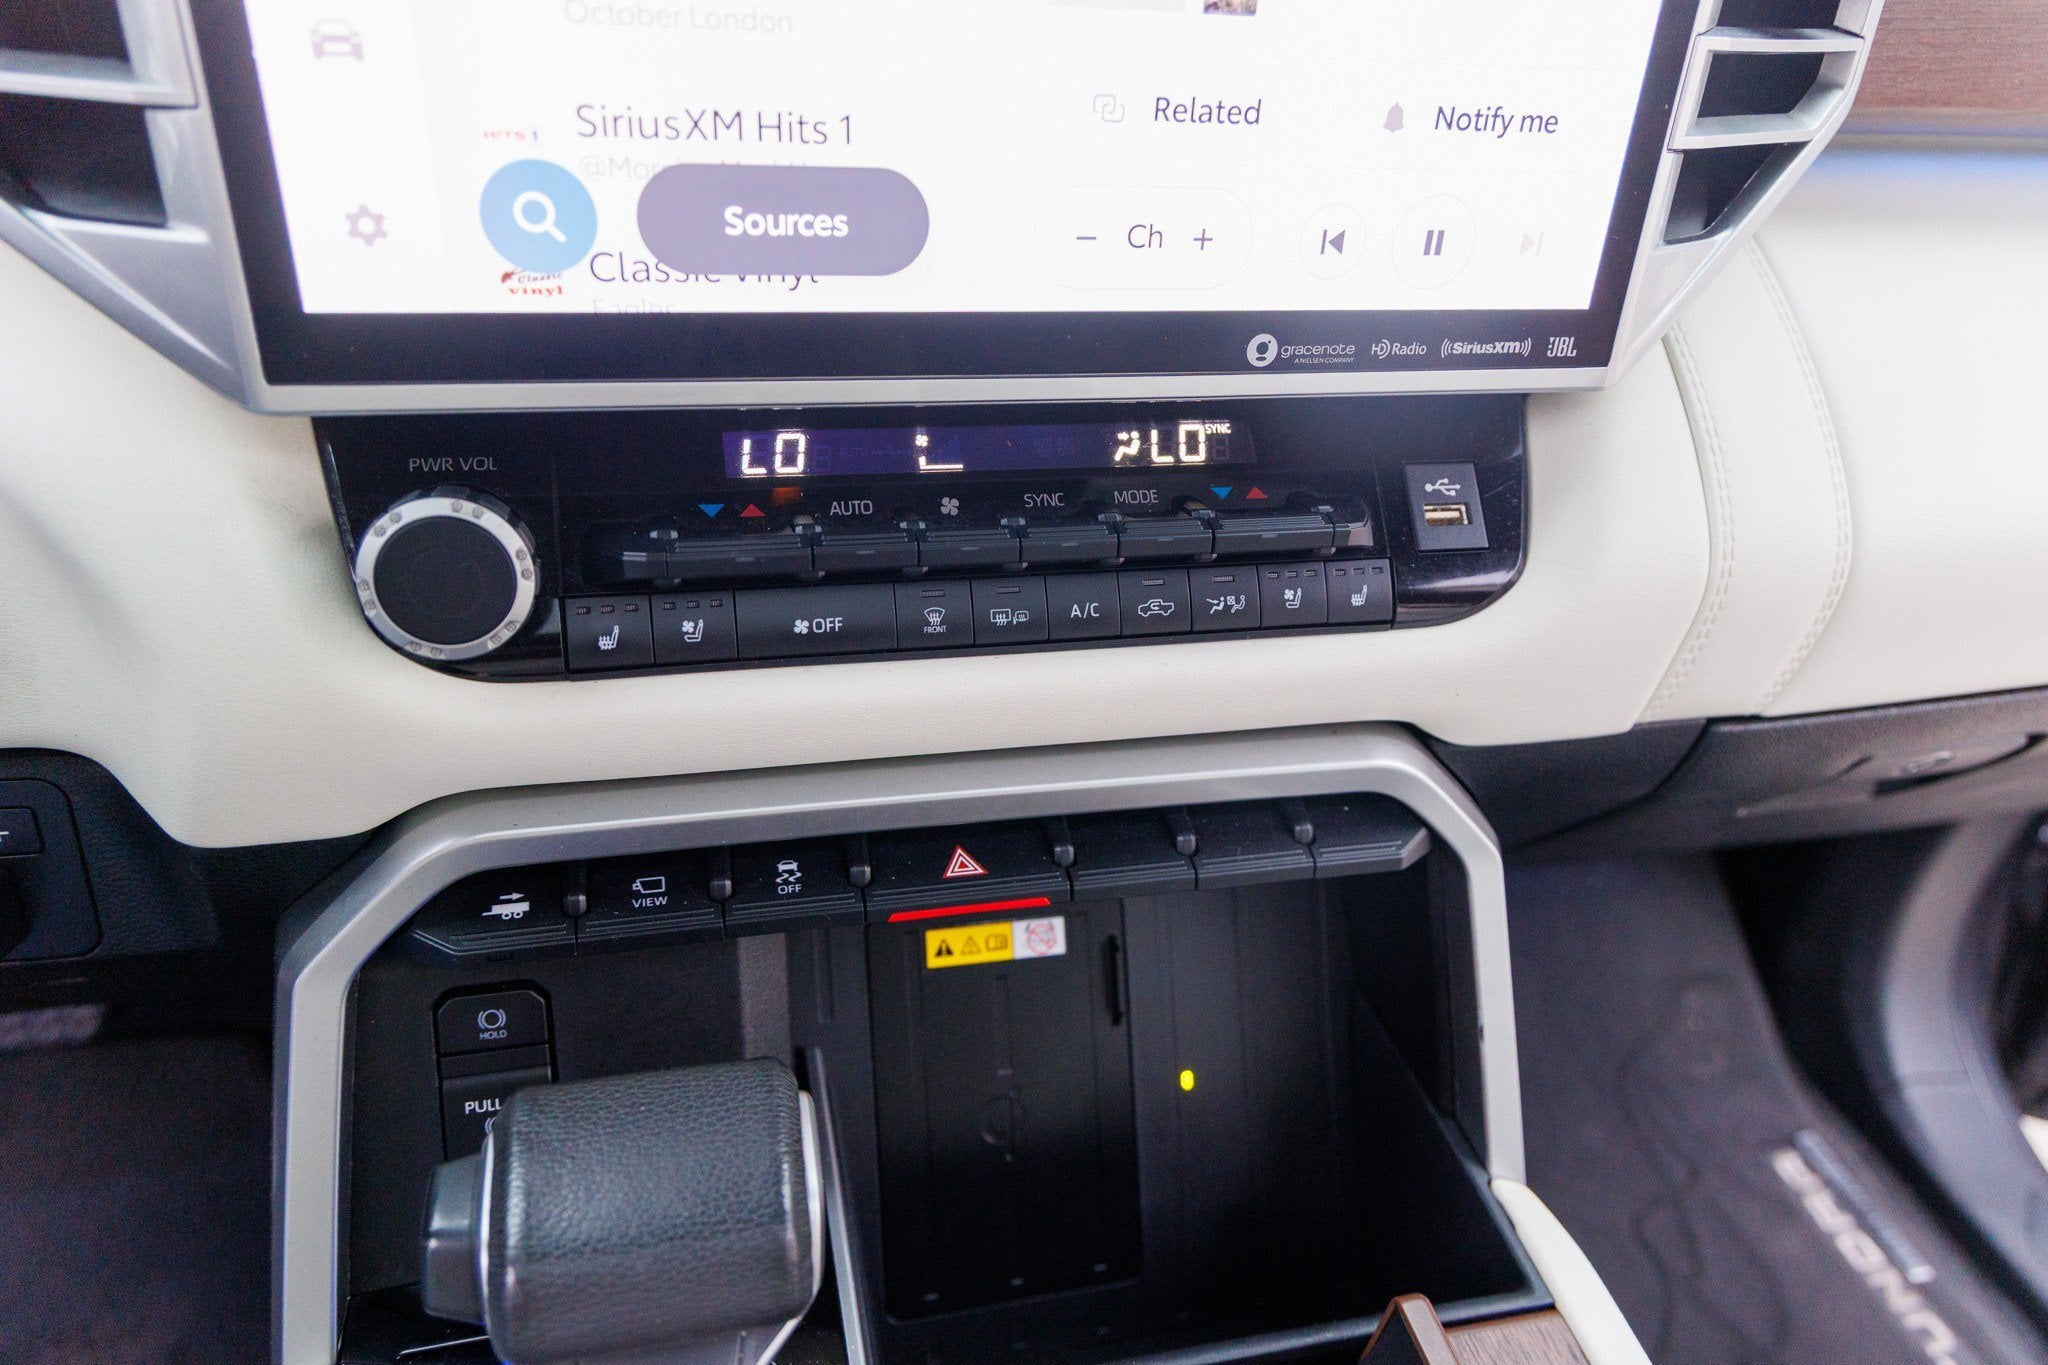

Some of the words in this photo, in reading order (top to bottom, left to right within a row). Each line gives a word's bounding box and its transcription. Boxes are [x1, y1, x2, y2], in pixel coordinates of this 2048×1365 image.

[564, 0, 682, 28] October
[690, 5, 793, 33] London
[1153, 96, 1262, 125] Related
[576, 104, 743, 141] SiriusXM
[757, 110, 828, 145] Hits
[840, 114, 852, 145] 1
[1434, 105, 1515, 139] Notify
[1519, 114, 1559, 134] me
[723, 205, 850, 238] Sources
[1127, 223, 1163, 249] Ch
[589, 251, 721, 283] Clas
[1281, 343, 1355, 359] gracenote
[1391, 341, 1427, 356] Radio
[1547, 336, 1578, 358] JBL
[1205, 423, 1232, 434] SYNC
[409, 457, 454, 472] PWR
[459, 456, 498, 471] VOL
[1023, 492, 1066, 508] SYNC
[1114, 489, 1159, 505] MODE
[830, 500, 873, 516] AUTO
[1070, 602, 1100, 619] A/C
[812, 616, 843, 634] OFF
[923, 624, 947, 634] FRONT
[777, 883, 802, 895] OFF
[632, 896, 668, 908] VIEW
[479, 1029, 507, 1040] HOLD
[464, 1097, 502, 1115] PULL
